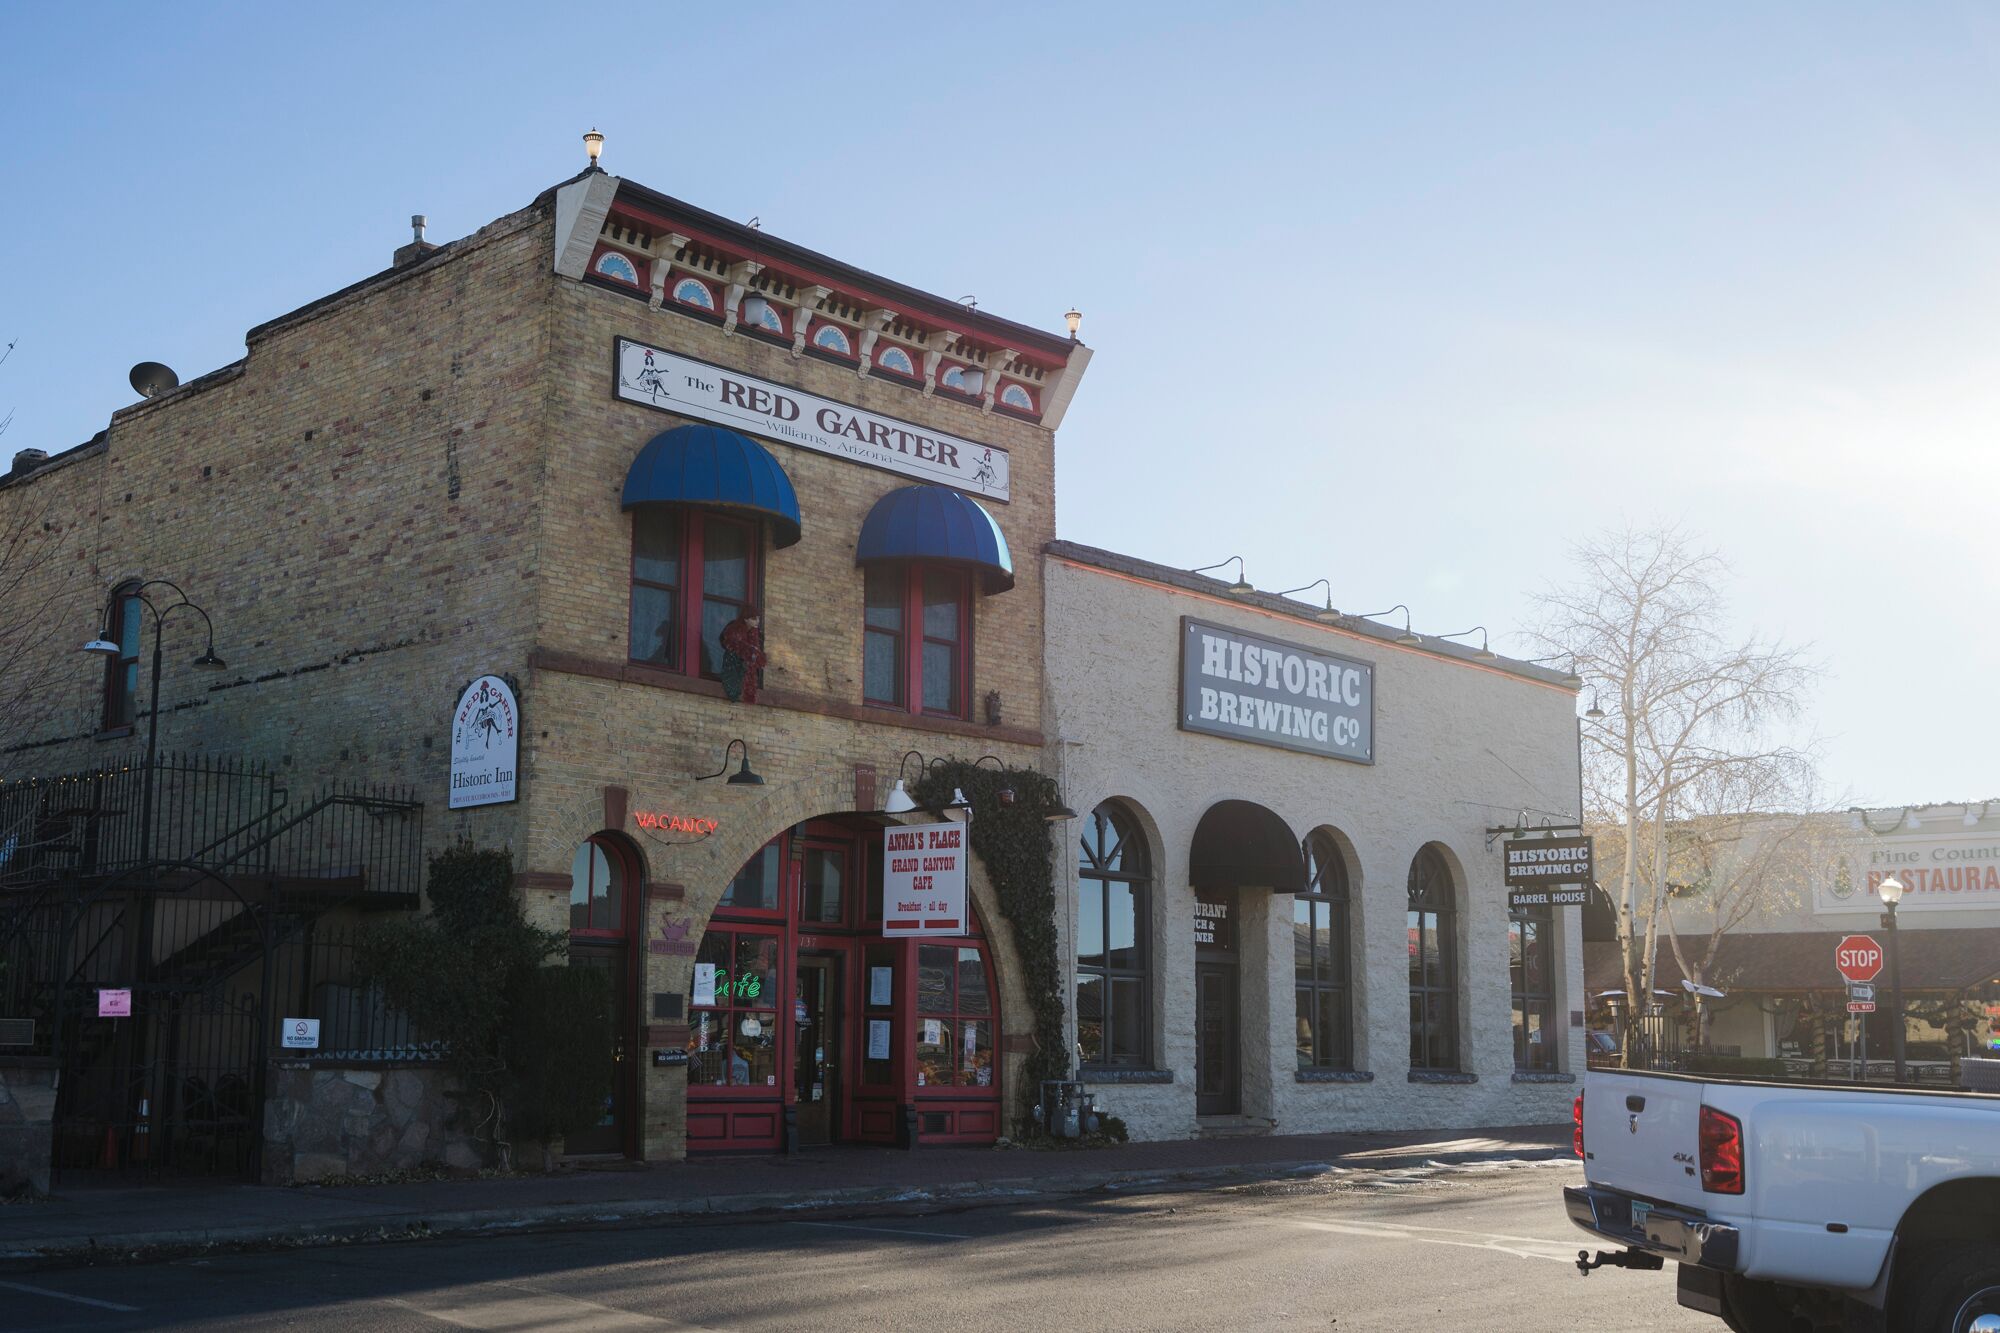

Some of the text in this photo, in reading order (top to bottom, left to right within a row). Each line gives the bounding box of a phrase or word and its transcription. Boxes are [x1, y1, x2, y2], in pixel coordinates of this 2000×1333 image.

[684, 375, 961, 468] The RED GARTER
[765, 420, 893, 464] Williams, Arizona
[1201, 634, 1360, 707] HISTORIC
[460, 692, 480, 724] RED
[490, 687, 514, 739] GARTER
[1200, 687, 1328, 742] BREWING
[453, 767, 512, 789] Historic Inn
[635, 811, 718, 833] VACANCY
[888, 830, 960, 851] ANNA'S PLACE
[1508, 847, 1588, 863] HISTORIC
[1872, 849, 1920, 864] Pine
[892, 856, 955, 872] GRAND CANYON
[1509, 864, 1572, 876] BREWING
[913, 876, 933, 890] CAFE
[1513, 892, 1586, 904] BARREL HOUSE
[898, 902, 922, 912] Breakfast
[939, 901, 947, 913] day
[1194, 903, 1227, 918] URANT
[1194, 932, 1214, 943] NER
[1840, 950, 1879, 967] STOP
[714, 969, 761, 998] Café
